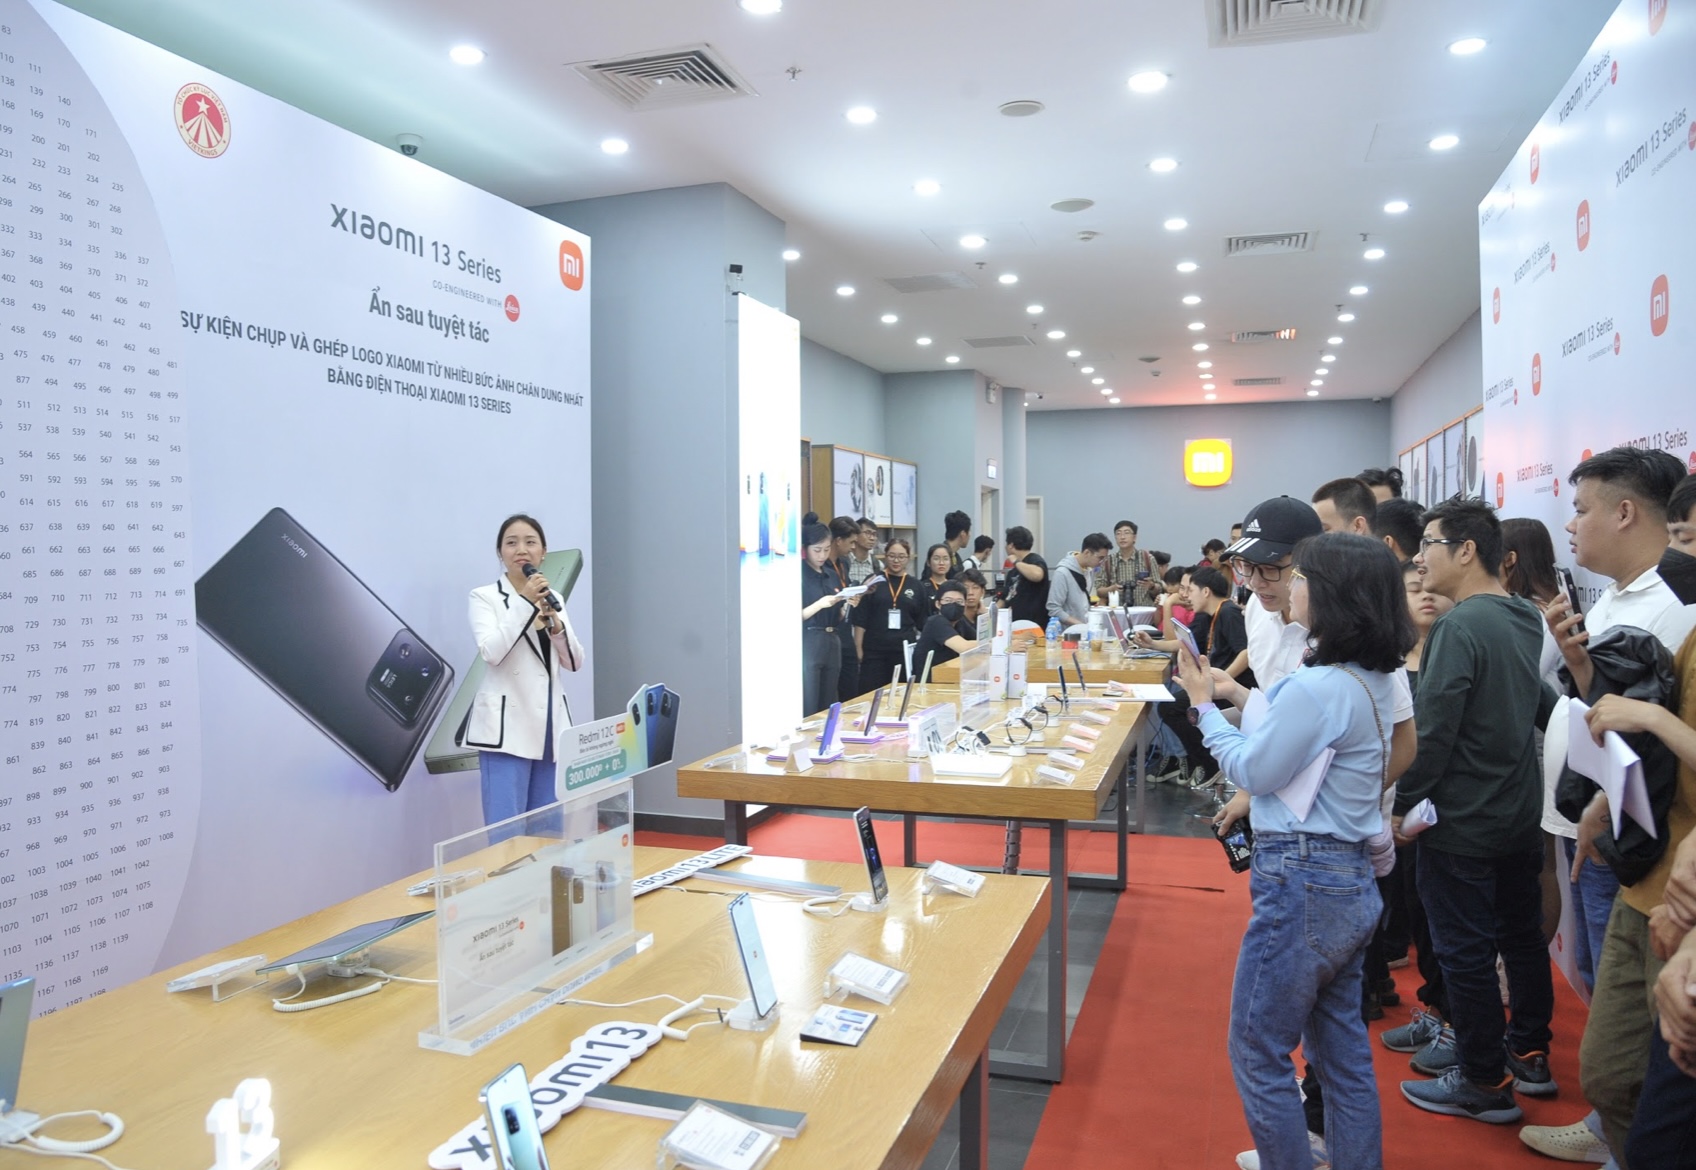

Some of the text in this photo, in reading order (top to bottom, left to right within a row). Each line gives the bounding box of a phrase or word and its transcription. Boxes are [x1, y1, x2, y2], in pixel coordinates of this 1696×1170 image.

[1584, 72, 1592, 92] 13
[1593, 50, 1610, 82] Series
[0, 75, 72, 106] 138 139 140
[1650, 129, 1660, 154] 13
[1662, 107, 1687, 142] Series
[188, 139, 218, 156] VIETKINGS
[1, 174, 122, 214] 264 265 266 267 268
[0, 248, 149, 288] 367 368 369 370 371 372
[431, 240, 451, 267] 13
[457, 250, 502, 284] Series
[432, 279, 502, 309] CO-ENGINEERED WITH
[368, 285, 490, 343] Ẩn sau tuyệt tác
[1588, 324, 1594, 343] 13
[1596, 317, 1613, 338] Series
[13, 349, 178, 377] 475 476 477 478 479 480 481
[180, 310, 584, 407] SỰ KIỆN CHỤP VÀ GHÉP LOGO XIAOMI TỪ NHIỀU BỨC ẢNH CHÂN DUNG NHẤT
[327, 365, 512, 415] BẰNG ĐIỆN THOẠI XIAOMI 13 SERIES
[18, 422, 182, 453] 537 538 539 540 541 542 543
[1664, 428, 1688, 450] Series
[1540, 462, 1554, 477] Series
[19, 522, 186, 539] 637 638 639 640 641 642 643
[24, 590, 167, 604] 709 710 711 712 713 714
[2, 656, 170, 694] 774 775 776 777 778 779 780
[578, 730, 600, 746] Redmi
[601, 725, 614, 739] 12C
[6, 744, 174, 775] 861 862 863 864 865 866 867
[25, 809, 171, 852] 968 969 970 971 972 973
[3, 900, 154, 957] 1103 1104 1105 1106 1107 1108
